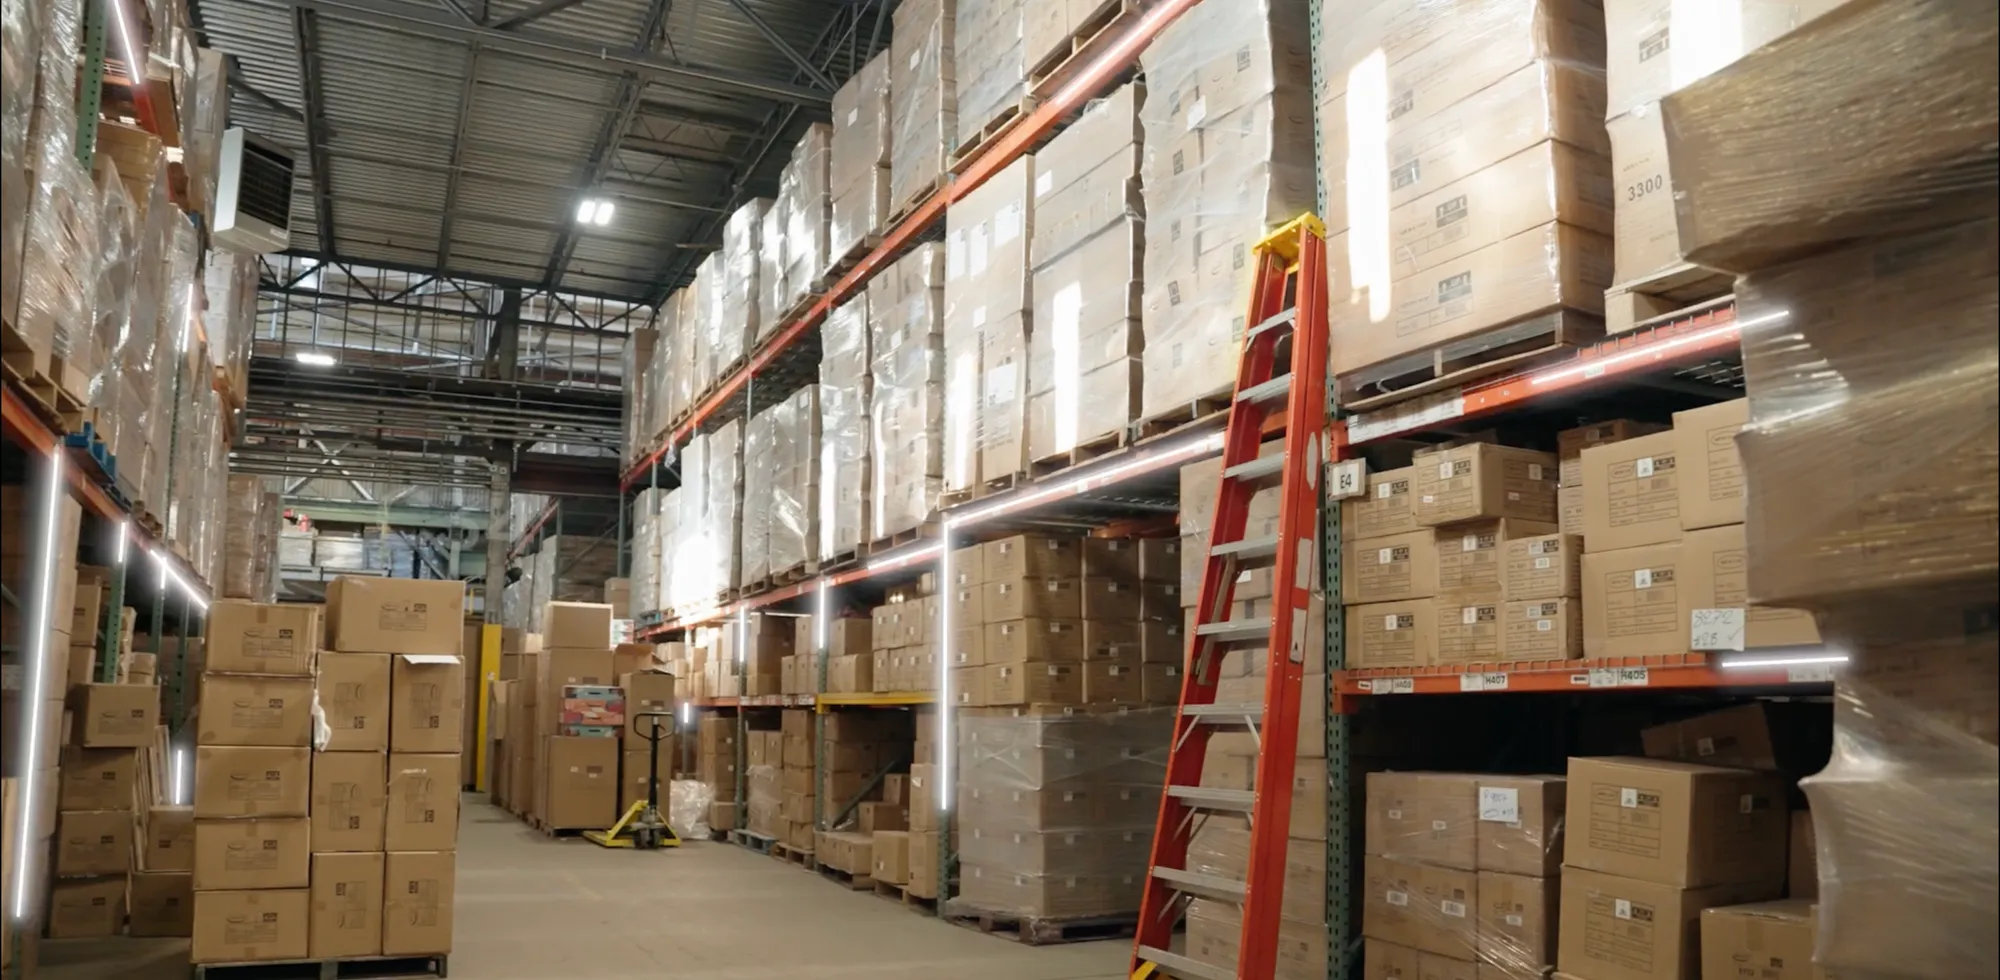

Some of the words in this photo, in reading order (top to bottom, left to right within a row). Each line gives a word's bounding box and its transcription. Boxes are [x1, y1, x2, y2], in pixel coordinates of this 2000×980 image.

[1627, 173, 1663, 201] 3300
[1340, 473, 1352, 489] E4
[1485, 675, 1506, 685] H407
[1620, 669, 1646, 681] H405
